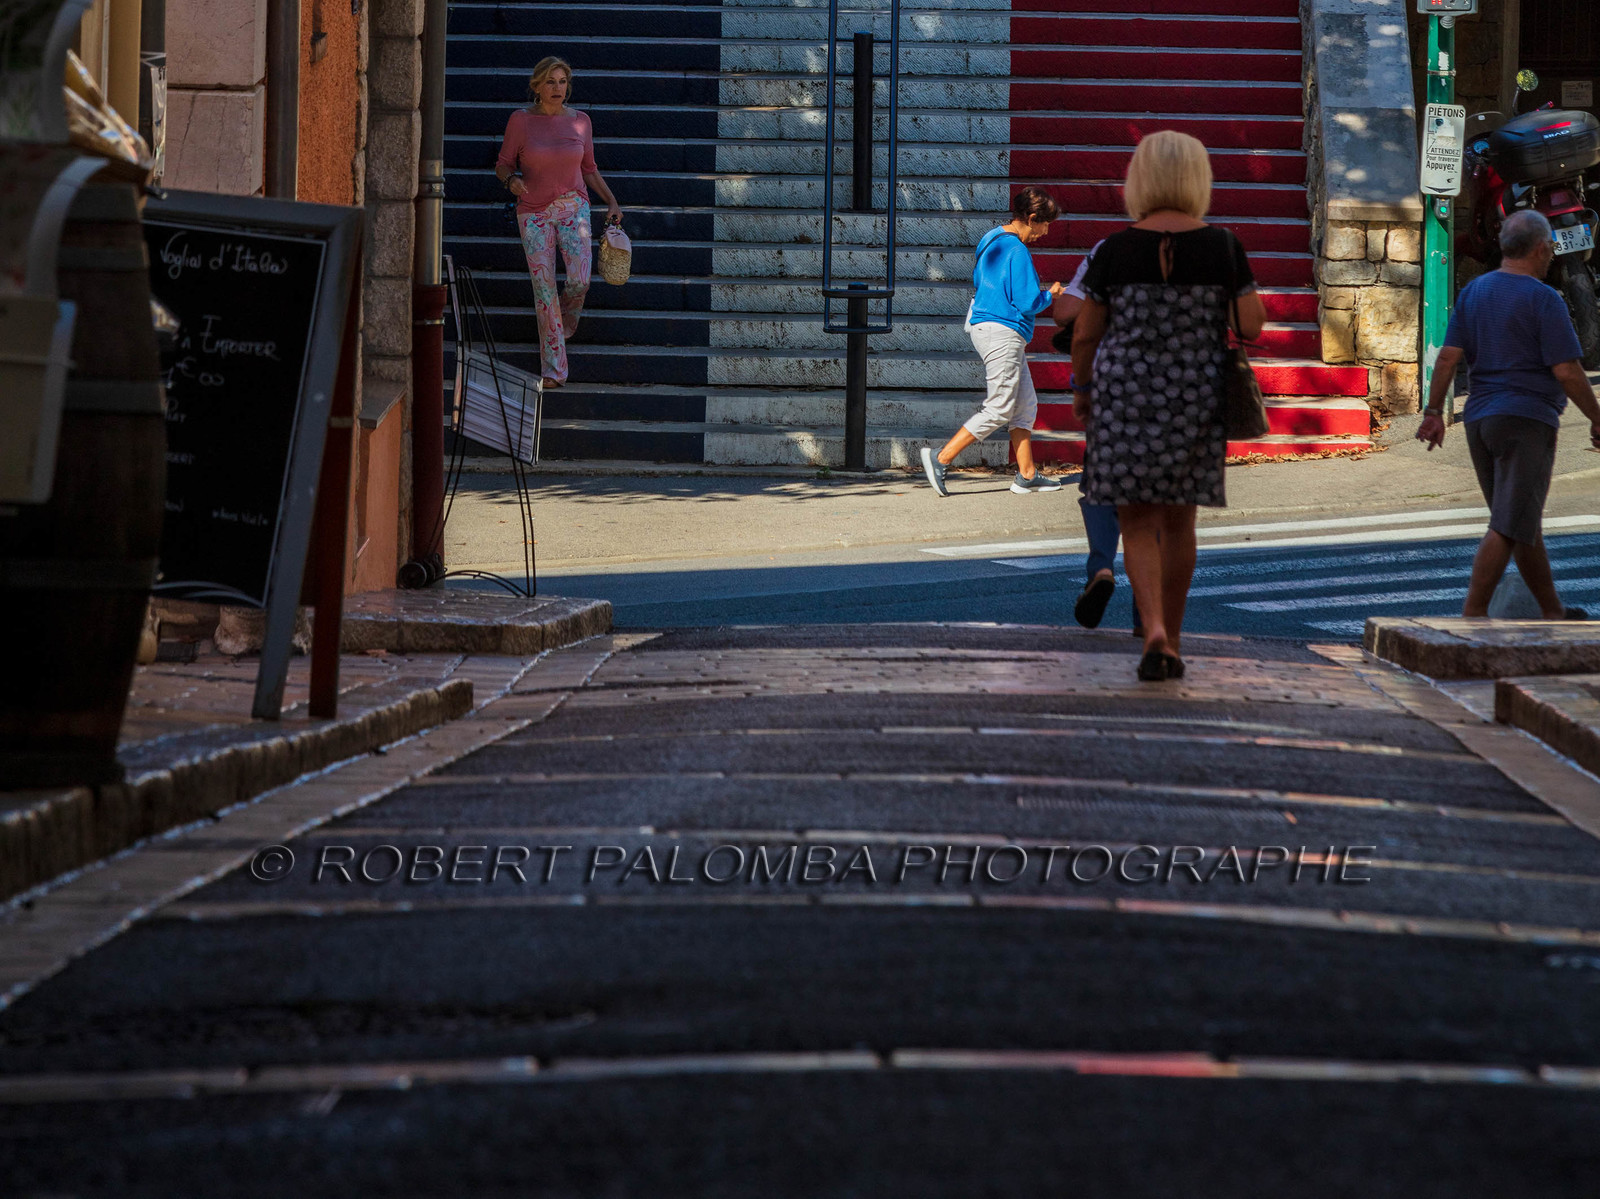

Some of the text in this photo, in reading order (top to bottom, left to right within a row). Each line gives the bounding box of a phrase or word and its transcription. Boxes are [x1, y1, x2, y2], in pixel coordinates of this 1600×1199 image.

[1428, 106, 1464, 118] PIÉTONS
[1430, 147, 1460, 156] ATTENDEZ
[1425, 161, 1455, 171] Appuyez
